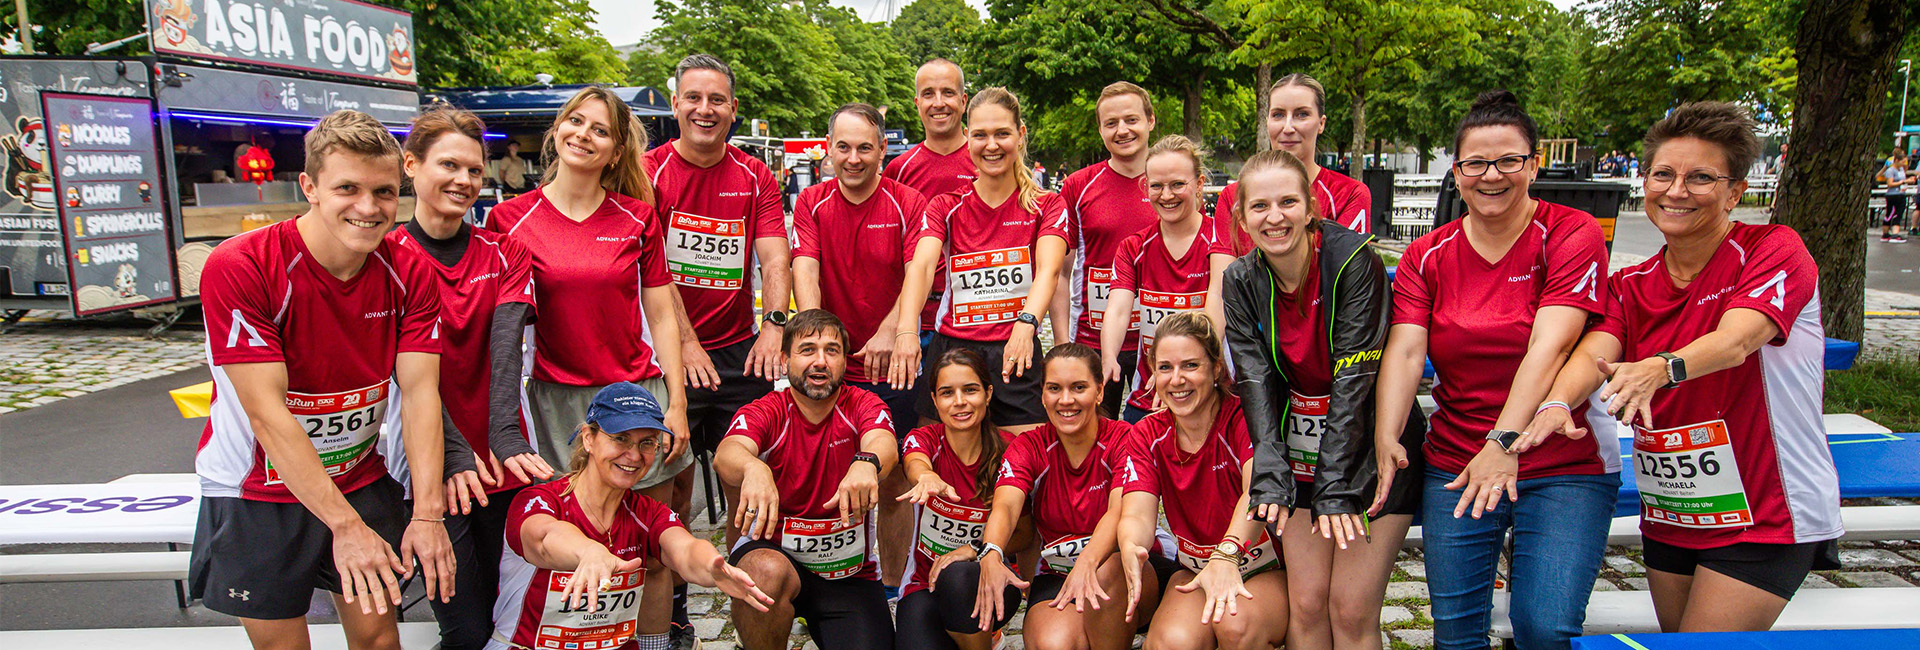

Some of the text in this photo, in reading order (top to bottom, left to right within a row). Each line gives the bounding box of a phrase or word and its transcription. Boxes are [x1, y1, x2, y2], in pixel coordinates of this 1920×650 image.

[204, 0, 386, 72] ASIA FOOD
[72, 123, 131, 146] NOODLES
[77, 155, 143, 175] DUMPLINGS
[81, 184, 121, 204] CURRY
[0, 217, 30, 229] ASIAN
[86, 212, 164, 236] SPRINGROLLS
[716, 222, 728, 232] 20
[677, 232, 739, 255] 12565
[91, 243, 139, 266] SNACKS
[991, 253, 1003, 262] 20
[958, 267, 1023, 290] 12566
[974, 288, 1009, 296] KATHARINA
[1174, 296, 1186, 304] 20
[364, 311, 389, 319] ADVANT
[342, 393, 361, 406] 20
[306, 406, 377, 438] 2561
[1290, 415, 1328, 437] 125
[322, 436, 349, 444] Anselm
[1662, 432, 1683, 446] 20
[335, 451, 352, 460] 17:00
[1636, 451, 1721, 479] 12556
[1657, 480, 1697, 489] MICHAELA
[969, 511, 983, 520] 20
[831, 521, 843, 531] 20
[930, 514, 983, 538] 1256
[793, 529, 857, 553] 12553
[558, 590, 637, 613] 12570
[583, 613, 609, 621] ULRIKE
[623, 623, 629, 632] B
